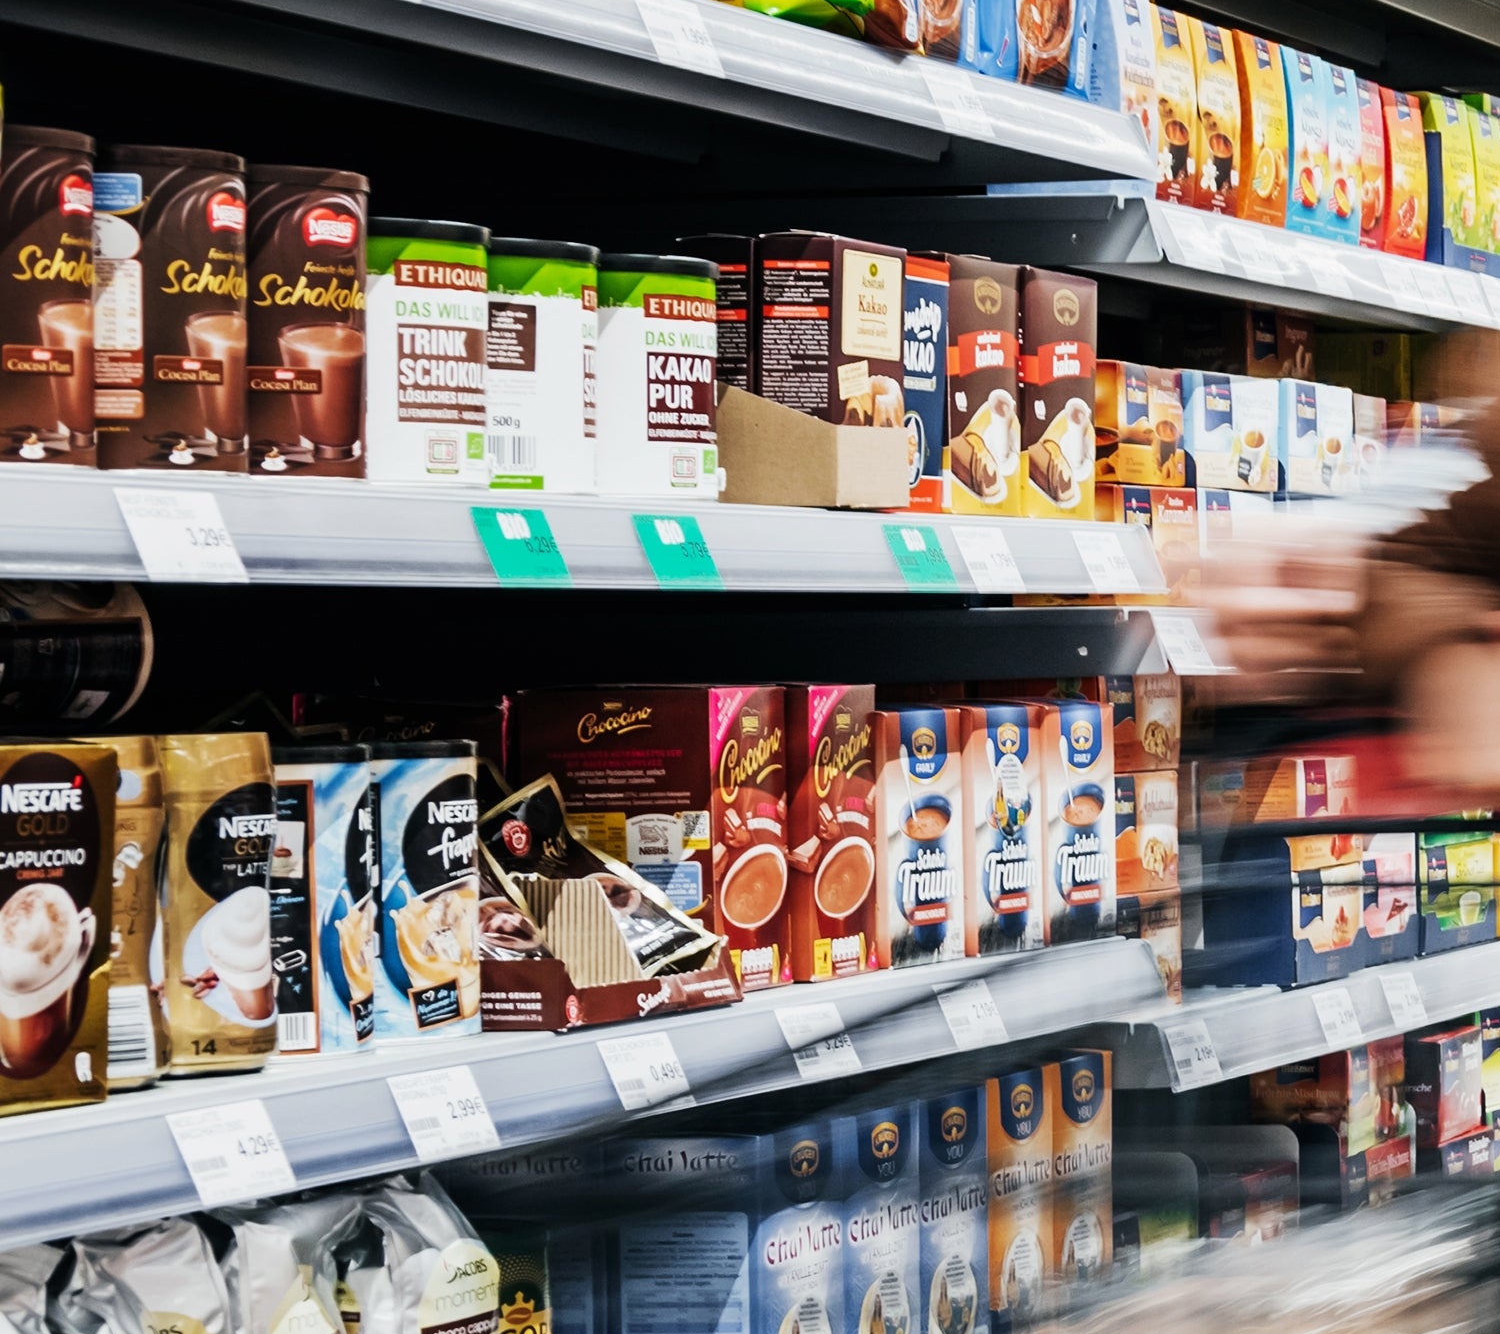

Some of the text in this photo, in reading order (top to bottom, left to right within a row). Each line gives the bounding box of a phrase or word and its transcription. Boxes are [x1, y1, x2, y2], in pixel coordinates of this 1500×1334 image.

[309, 220, 354, 239] Nestlé
[396, 301, 467, 320] DAS WILL
[858, 296, 888, 315] Kakao
[399, 328, 467, 357] TRINK
[645, 331, 705, 348] DAS WILL
[7, 358, 71, 373] Cocoa Plan
[975, 345, 1005, 369] kakao
[1053, 355, 1081, 378] kakao
[159, 370, 221, 383] Cocoa Plan
[649, 355, 712, 384] KAKAO
[251, 379, 318, 392] Cocoa Plan
[649, 383, 693, 410] PUR
[400, 389, 456, 405] LÖSLICHES
[492, 415, 513, 427] 500
[649, 412, 678, 425] OHNE
[498, 512, 531, 541] BIO
[653, 520, 686, 546] BIO
[189, 530, 231, 549] 3,29€
[525, 536, 559, 556] 6,29€
[900, 528, 925, 552] BIO
[577, 707, 652, 745] Chococino
[720, 727, 781, 804] Chococino
[814, 723, 871, 798] Chococino
[1, 776, 82, 813] NESCAFÉ
[16, 813, 69, 836] GOLD
[639, 845, 671, 856] Nestlé
[1002, 840, 1027, 860] Schoko
[1074, 833, 1099, 855] Schoko
[0, 849, 86, 868] CAPPUCCINO
[917, 848, 946, 871] Schoko
[1057, 844, 1109, 884] Traum
[898, 862, 957, 901] Traum
[985, 851, 1036, 890] Traum
[493, 1001, 542, 1010] EINE TASSE
[508, 991, 542, 1000] GENUSS
[191, 1040, 217, 1056] 14
[649, 1063, 682, 1081] 0,49€
[447, 1098, 484, 1120] 2,99€
[1078, 1105, 1093, 1120] YOU
[1016, 1121, 1032, 1136] YOU
[238, 1137, 280, 1158] 4,29€
[947, 1144, 964, 1161] YOU
[1055, 1141, 1110, 1176] chai latte
[624, 1147, 739, 1175] chai latte
[878, 1161, 895, 1177] YOU
[994, 1157, 1050, 1197] chai latte
[921, 1183, 988, 1224] chai latte
[850, 1202, 919, 1243] chai latte
[766, 1221, 841, 1266] chai latte
